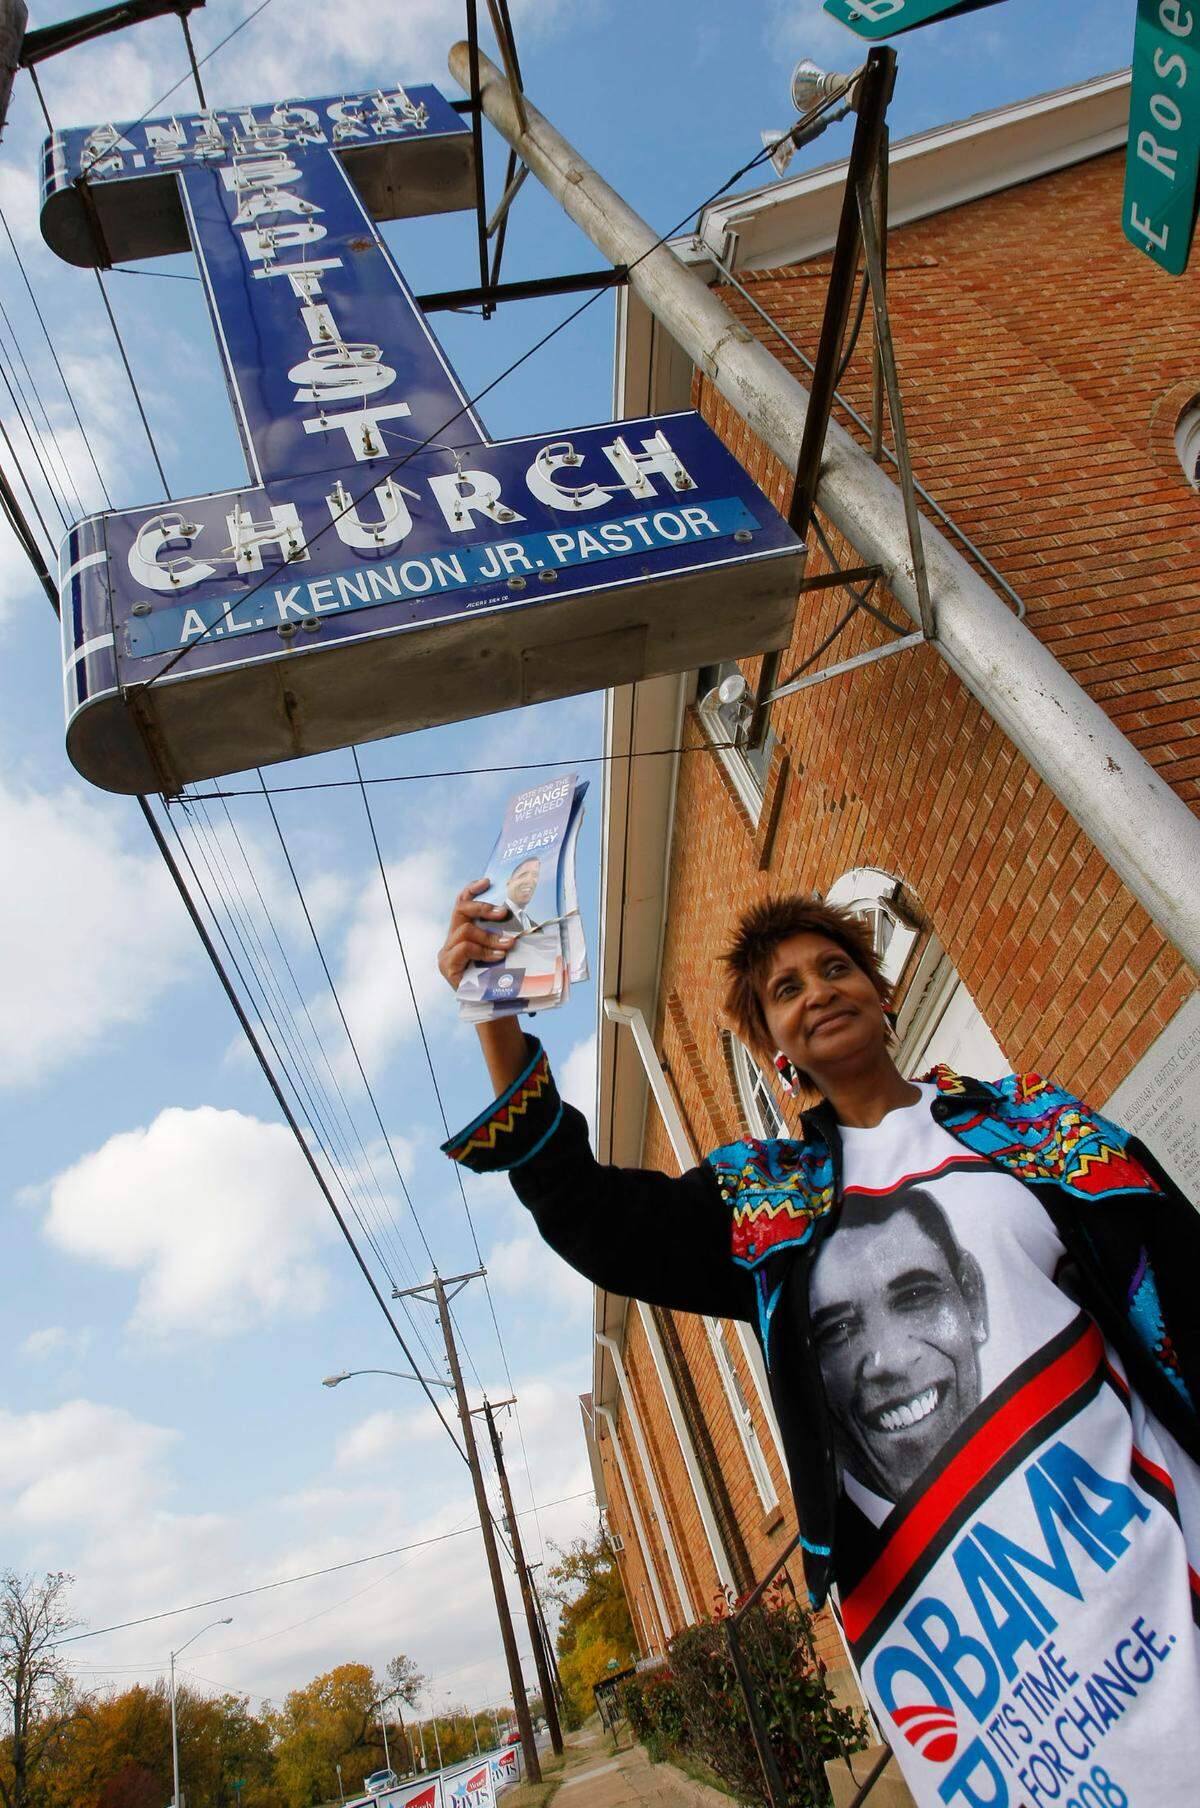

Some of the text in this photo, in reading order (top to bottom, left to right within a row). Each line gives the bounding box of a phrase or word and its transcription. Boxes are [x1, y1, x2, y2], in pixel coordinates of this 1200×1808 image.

[84, 90, 426, 152] ANTIOCH
[1130, 202, 1169, 251] E
[219, 158, 412, 462] BAPTIST
[127, 430, 699, 591] CHURCH
[180, 507, 720, 643] A.L. KENNON JR. PASTOR
[515, 784, 570, 814] CHANGE
[526, 833, 558, 852] EASY
[535, 797, 564, 816] NEED
[873, 1441, 1151, 1763] OBAMA
[986, 1641, 1080, 1769] IT'S TIME
[1017, 1616, 1177, 1808] FOR CHANGE.
